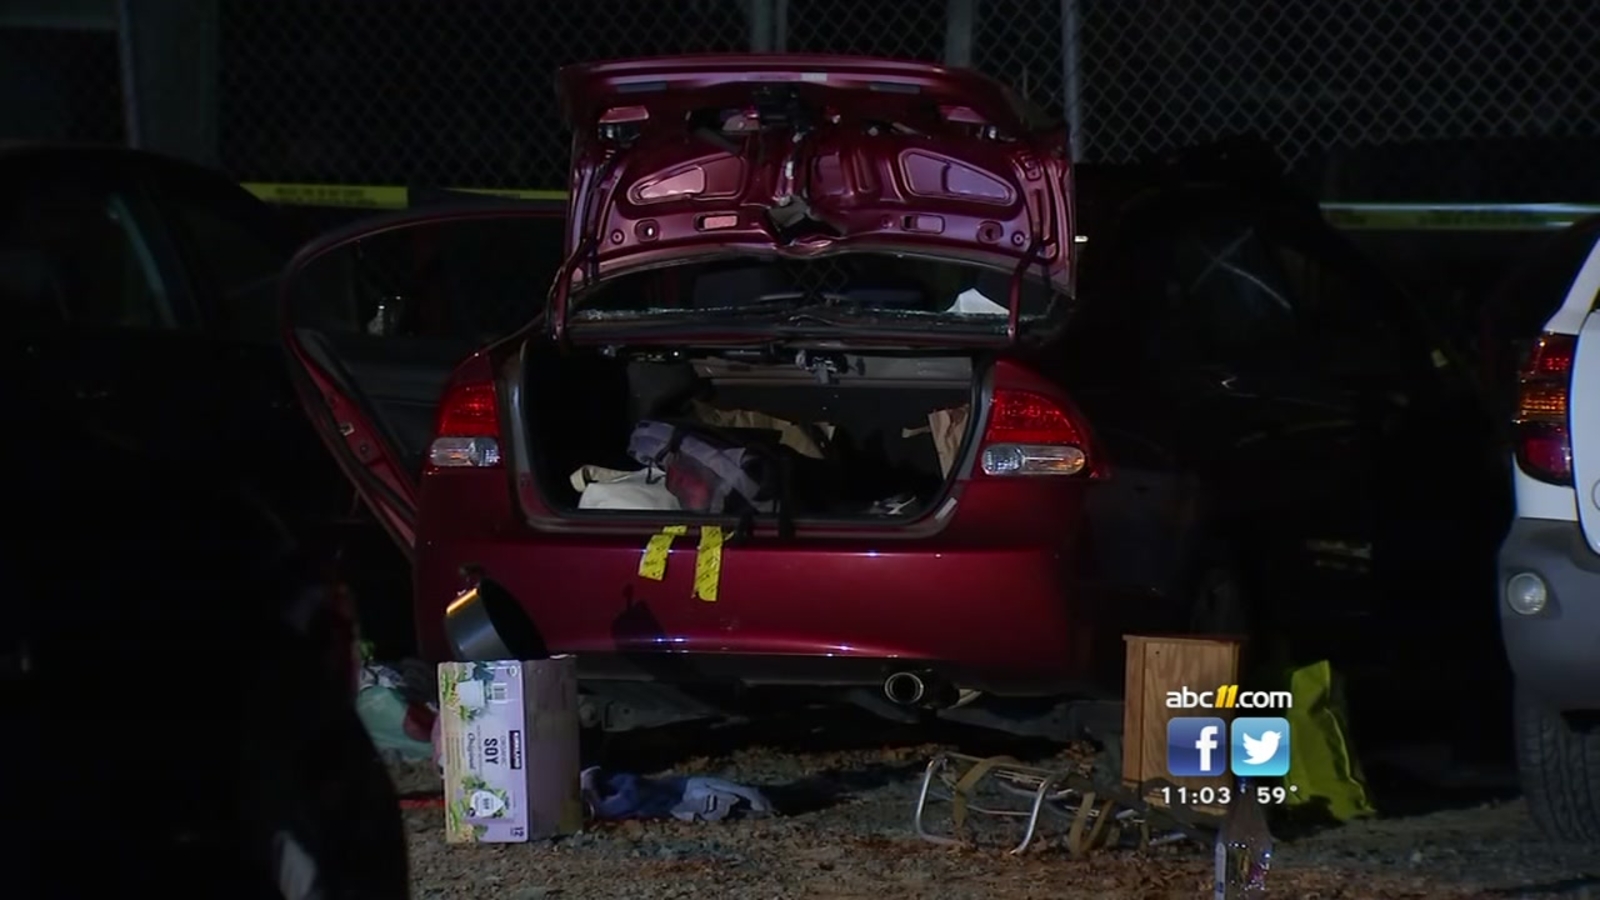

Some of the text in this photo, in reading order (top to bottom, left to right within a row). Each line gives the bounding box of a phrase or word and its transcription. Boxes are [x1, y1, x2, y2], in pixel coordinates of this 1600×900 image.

[467, 732, 477, 770] Original
[484, 738, 499, 765] SOY
[513, 732, 521, 768] KIRKLAND
[514, 826, 524, 837] 12
